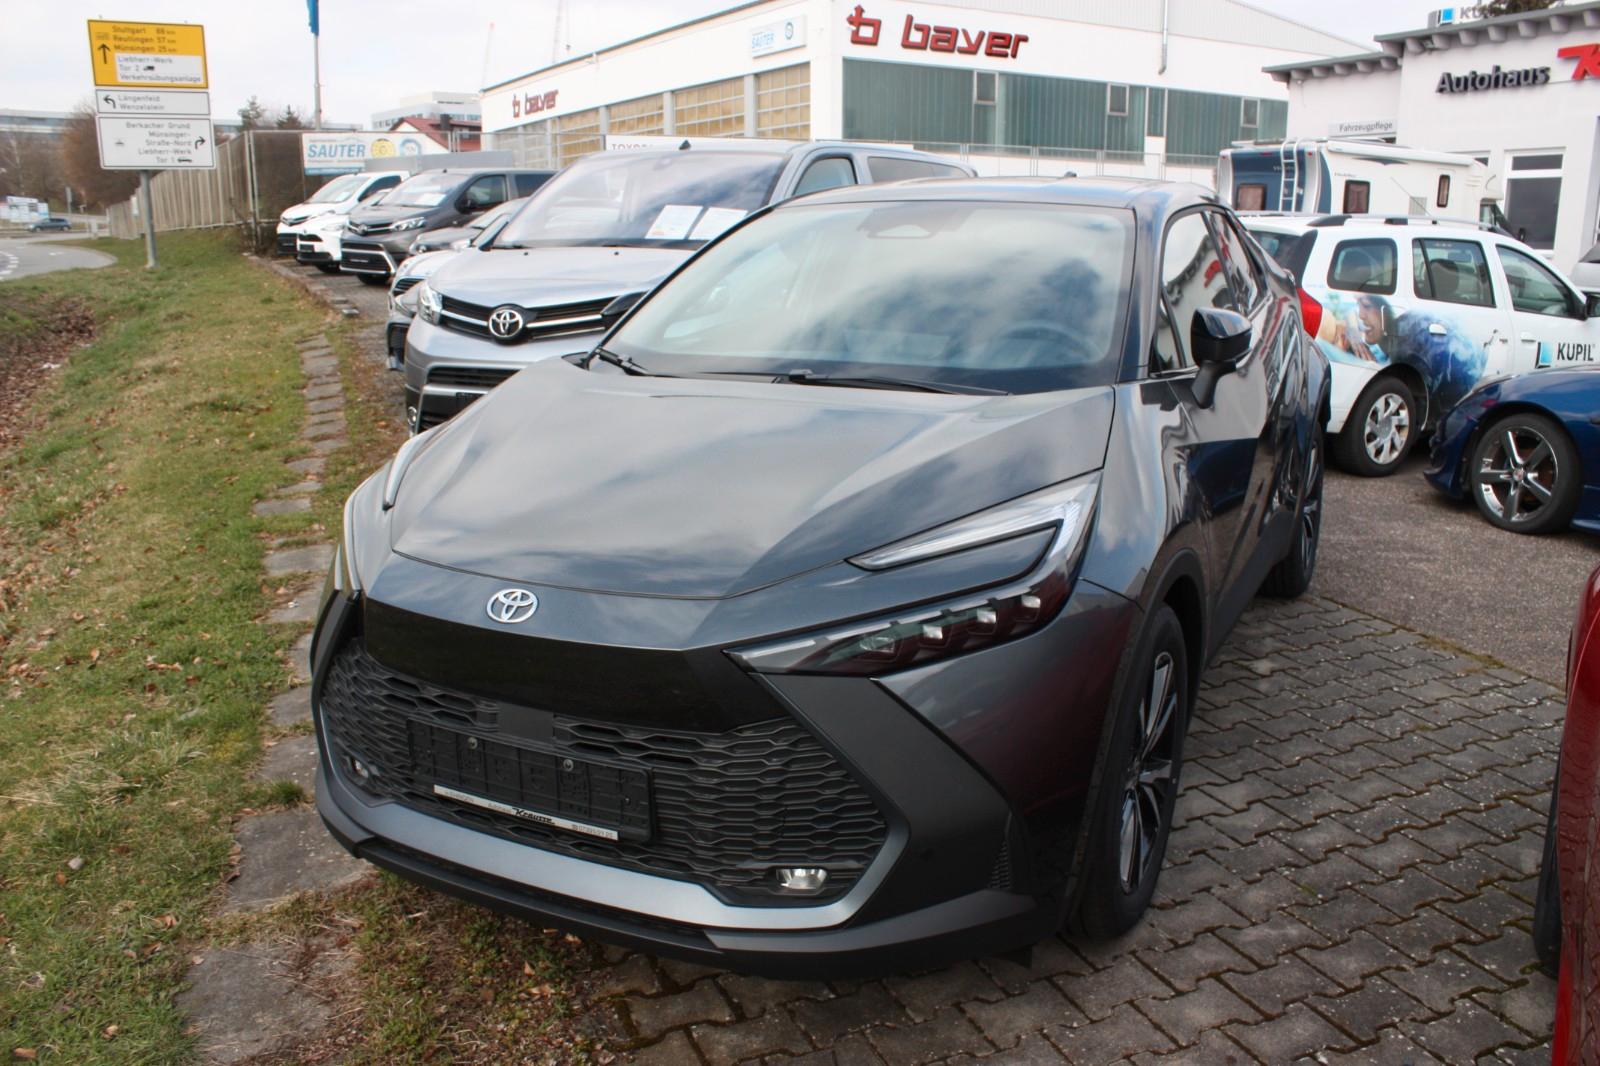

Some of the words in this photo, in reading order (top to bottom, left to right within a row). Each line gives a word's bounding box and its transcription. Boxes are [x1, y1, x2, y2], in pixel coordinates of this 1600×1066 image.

[901, 14, 1029, 59] bayer
[1435, 65, 1551, 93] Autohaus
[1339, 120, 1393, 132] Fahrzeugpflege
[307, 144, 366, 158] SAUTER
[1557, 342, 1594, 361] KUPIL
